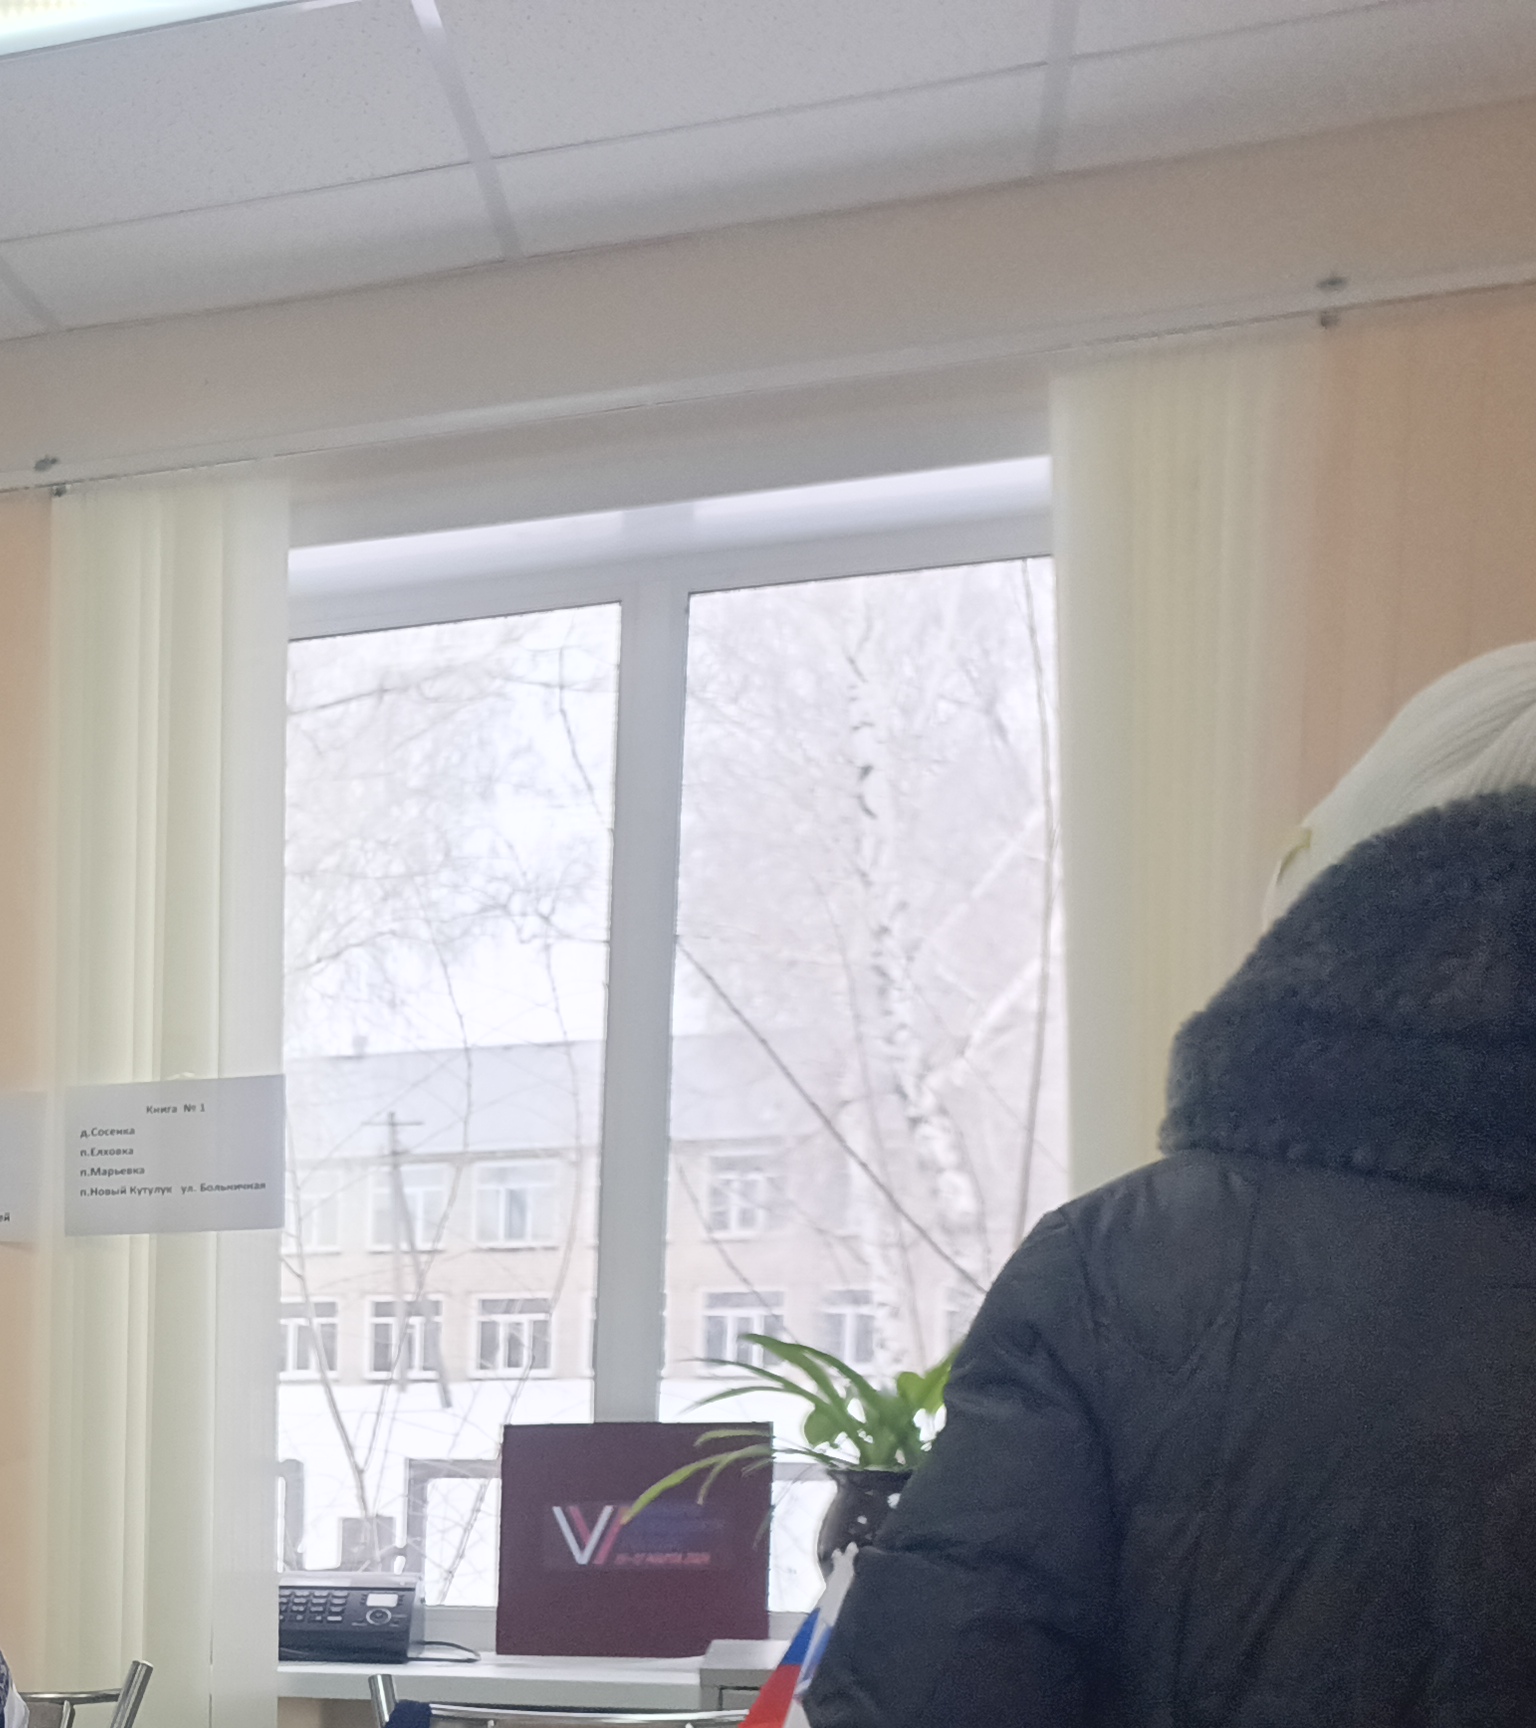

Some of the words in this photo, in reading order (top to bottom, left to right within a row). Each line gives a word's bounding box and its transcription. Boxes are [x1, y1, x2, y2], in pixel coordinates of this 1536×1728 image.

[146, 1105, 178, 1114] Книга
[183, 1103, 196, 1113] №
[200, 1103, 206, 1112] 1
[80, 1127, 136, 1139] д.Сосенка
[80, 1147, 134, 1157] п.Елховка
[80, 1167, 145, 1178] п.Марьевка
[80, 1185, 127, 1197] п.Новый
[130, 1185, 173, 1196] Кутулук
[181, 1185, 198, 1195] ул.
[200, 1182, 266, 1193] Больничная
